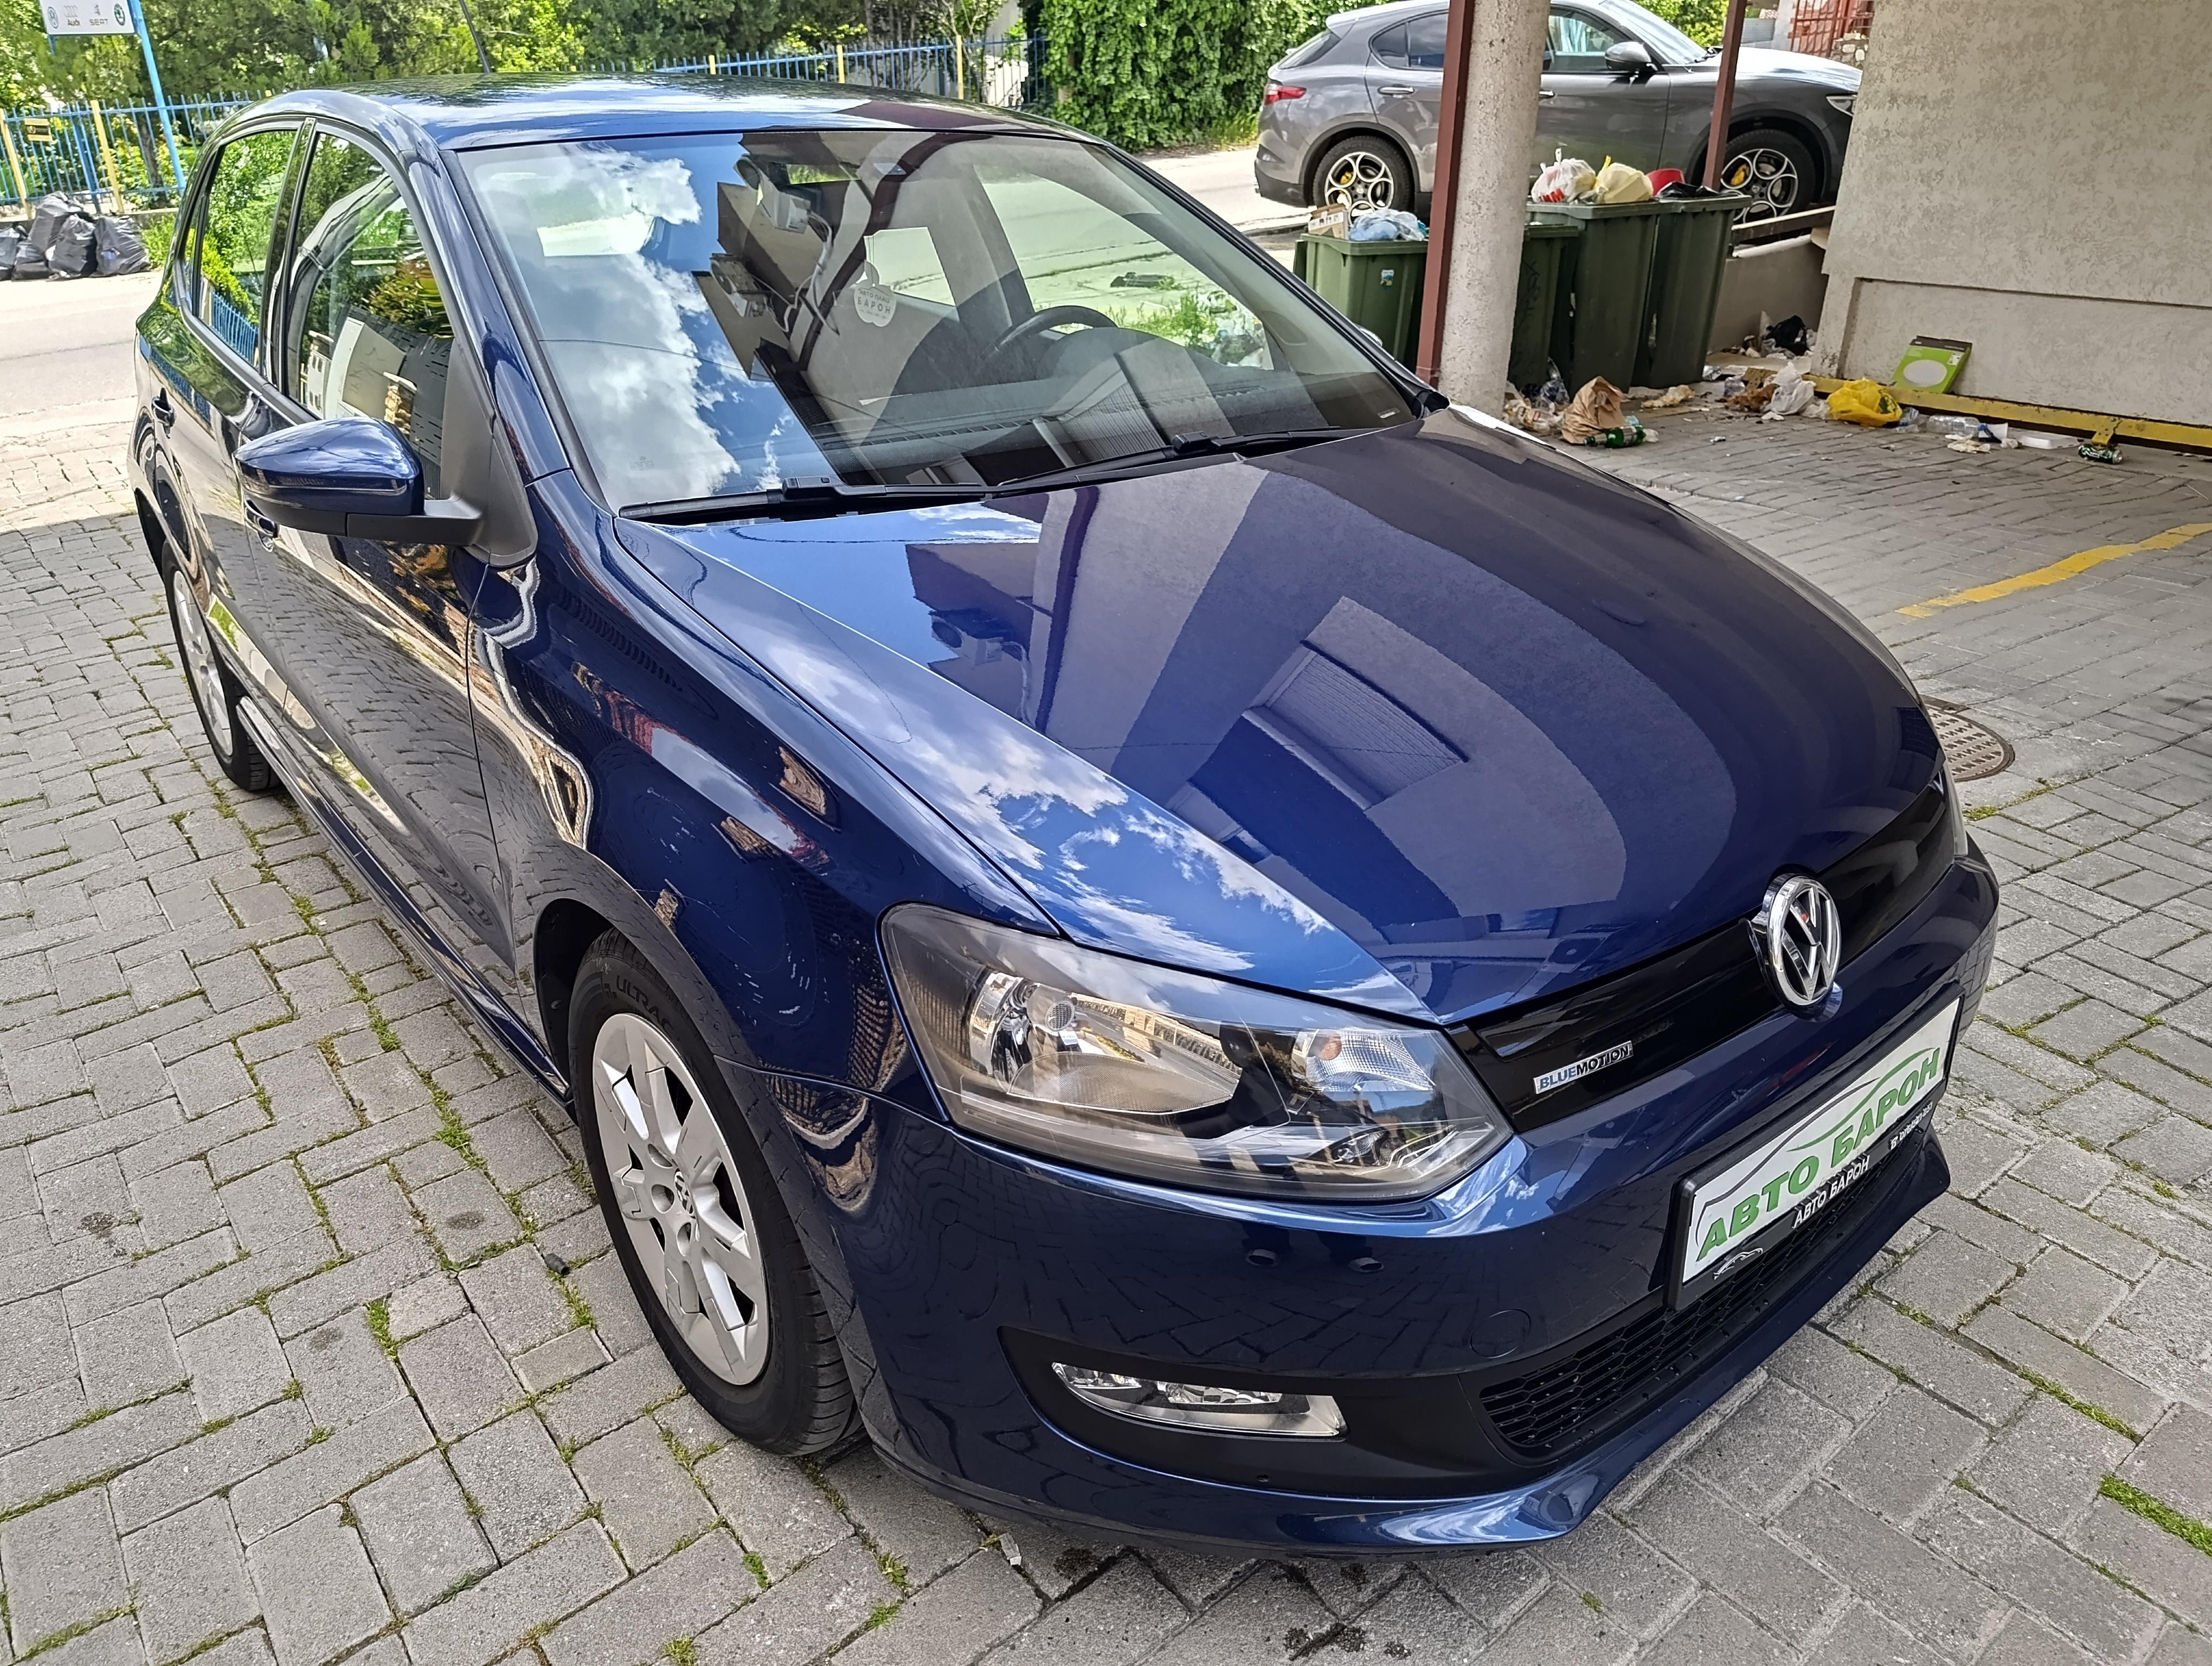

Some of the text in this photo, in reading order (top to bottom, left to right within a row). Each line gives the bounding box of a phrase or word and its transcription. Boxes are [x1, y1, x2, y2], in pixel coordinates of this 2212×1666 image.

[858, 297, 891, 314] БАРОН
[616, 975, 675, 1040] ULTRAC
[1540, 1044, 1631, 1090] BLUEMOTION
[1696, 1047, 1940, 1262] АВТО БАРОН
[1792, 1155, 1870, 1229] АВТО БАРОН
